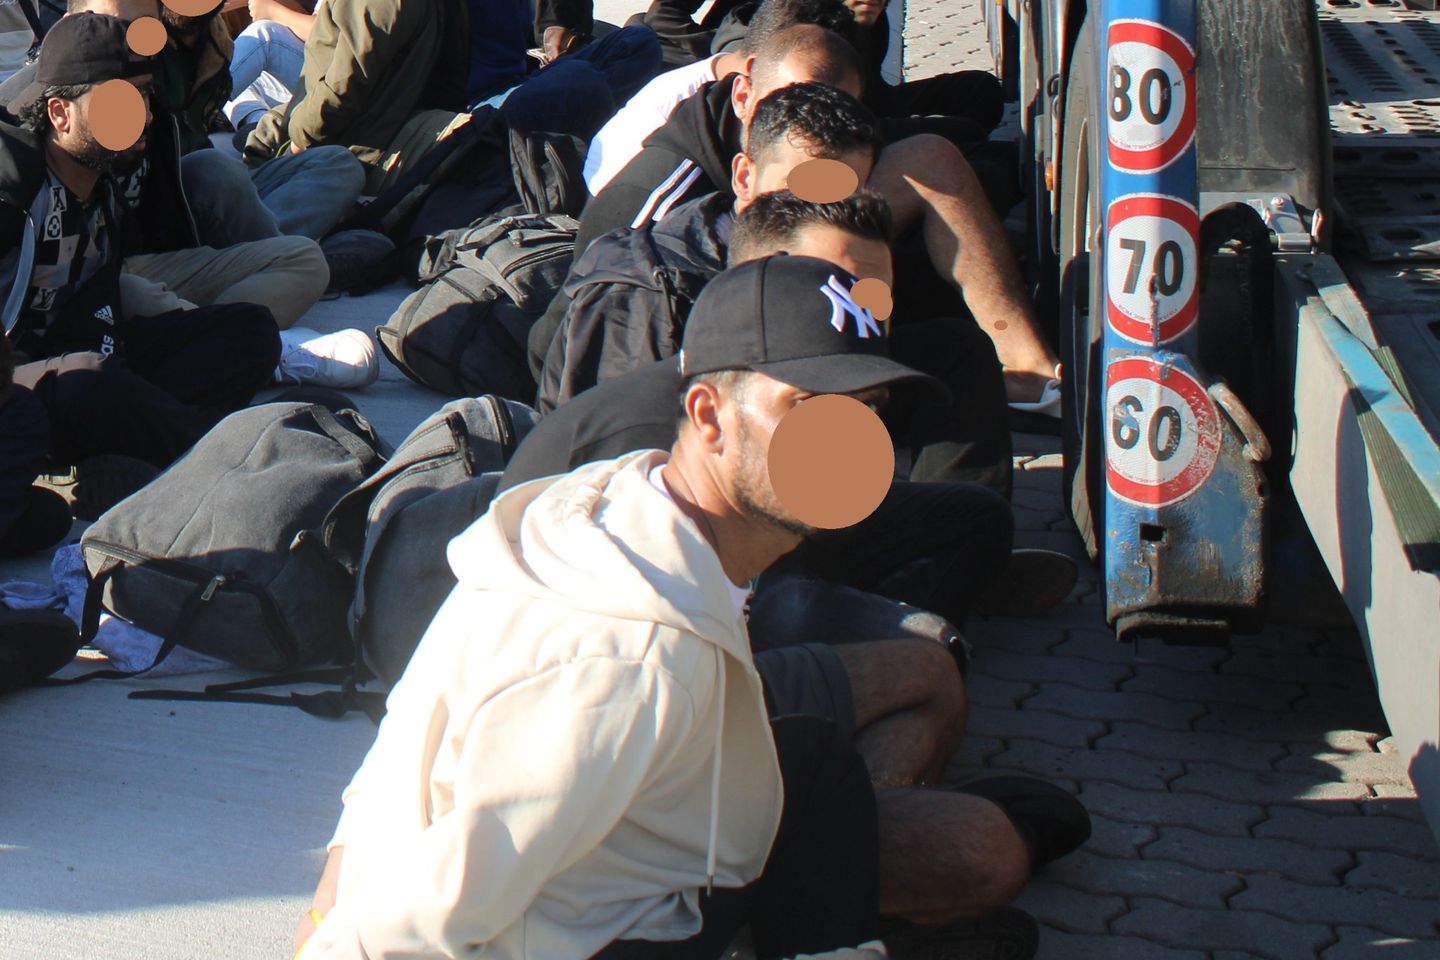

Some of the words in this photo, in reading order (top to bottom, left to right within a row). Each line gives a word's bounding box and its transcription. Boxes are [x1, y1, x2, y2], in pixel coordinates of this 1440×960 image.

[1110, 64, 1172, 125] 80
[1119, 237, 1184, 297] 70
[1111, 394, 1182, 462] 60
